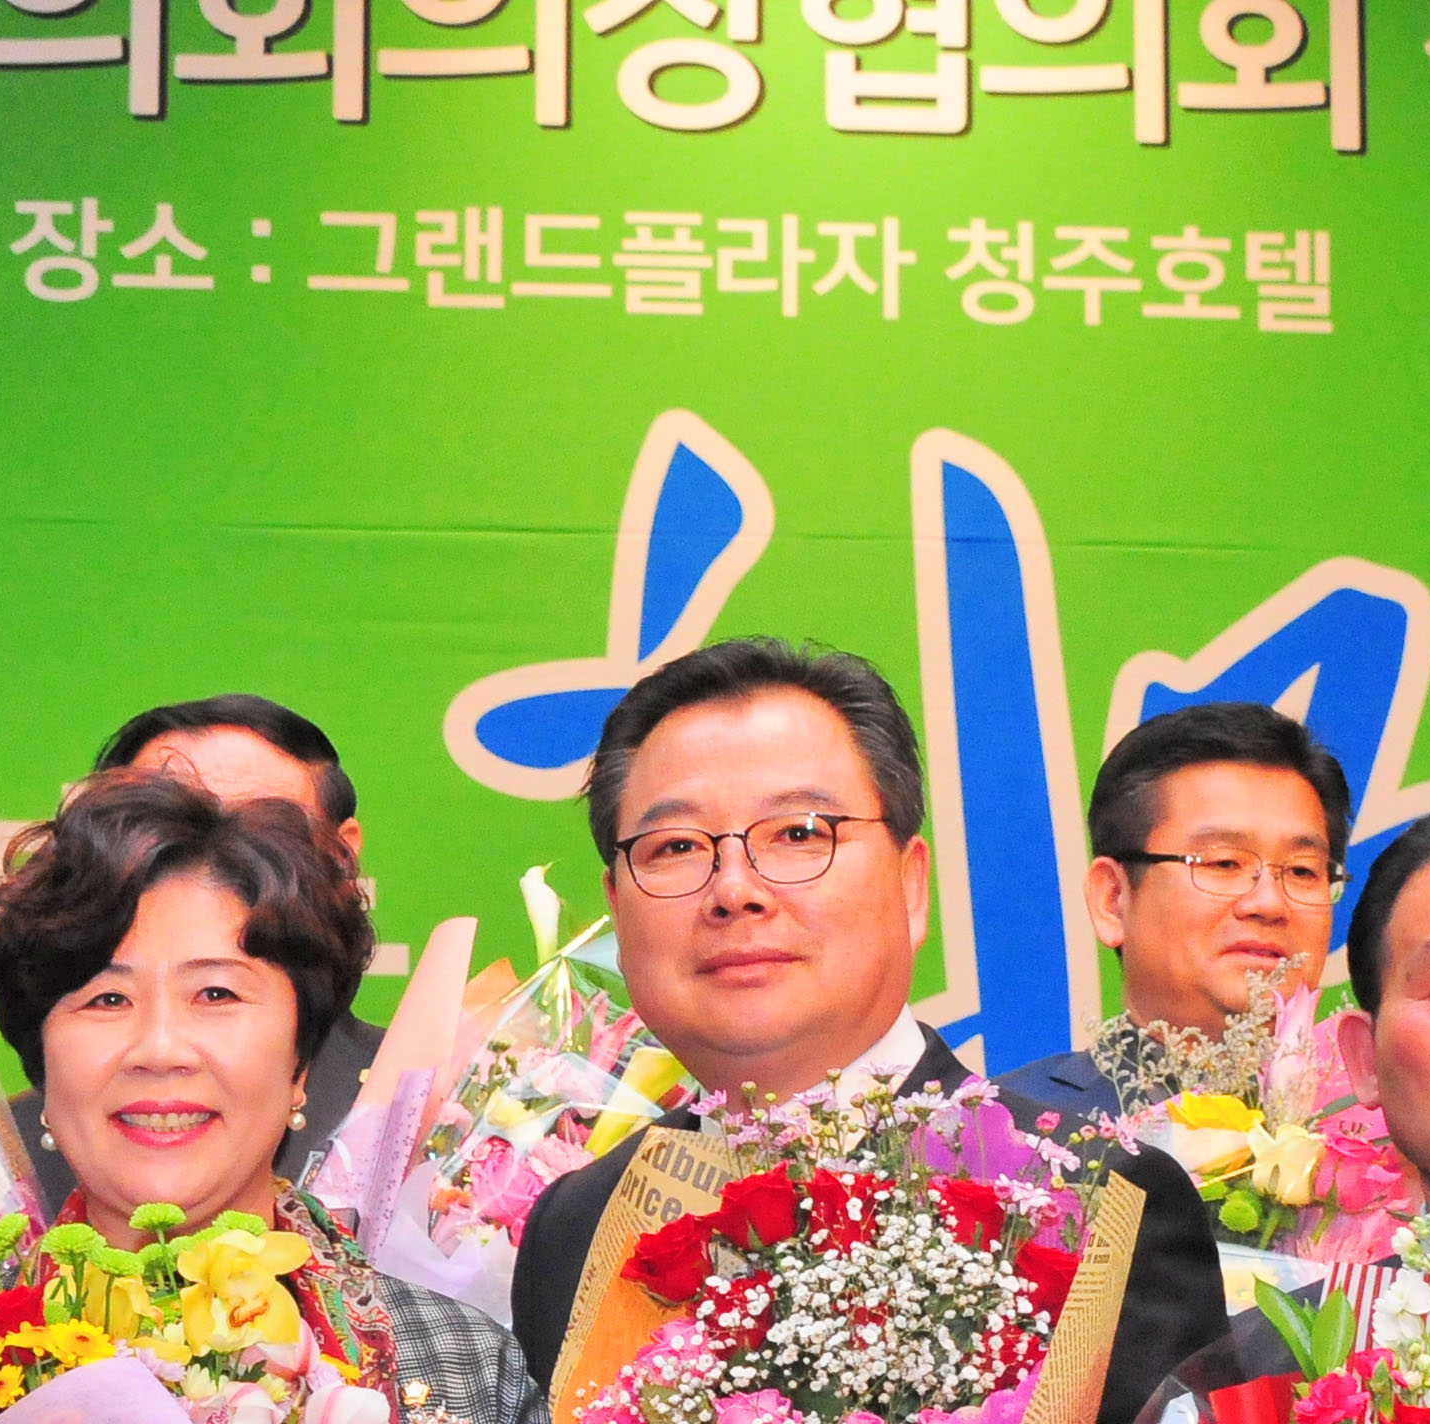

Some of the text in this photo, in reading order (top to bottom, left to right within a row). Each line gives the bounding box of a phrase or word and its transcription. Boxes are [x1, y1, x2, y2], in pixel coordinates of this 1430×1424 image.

[9, 197, 215, 303] 장소
[307, 205, 919, 321] 그랜드플라자
[944, 216, 1334, 335] 청주호텔
